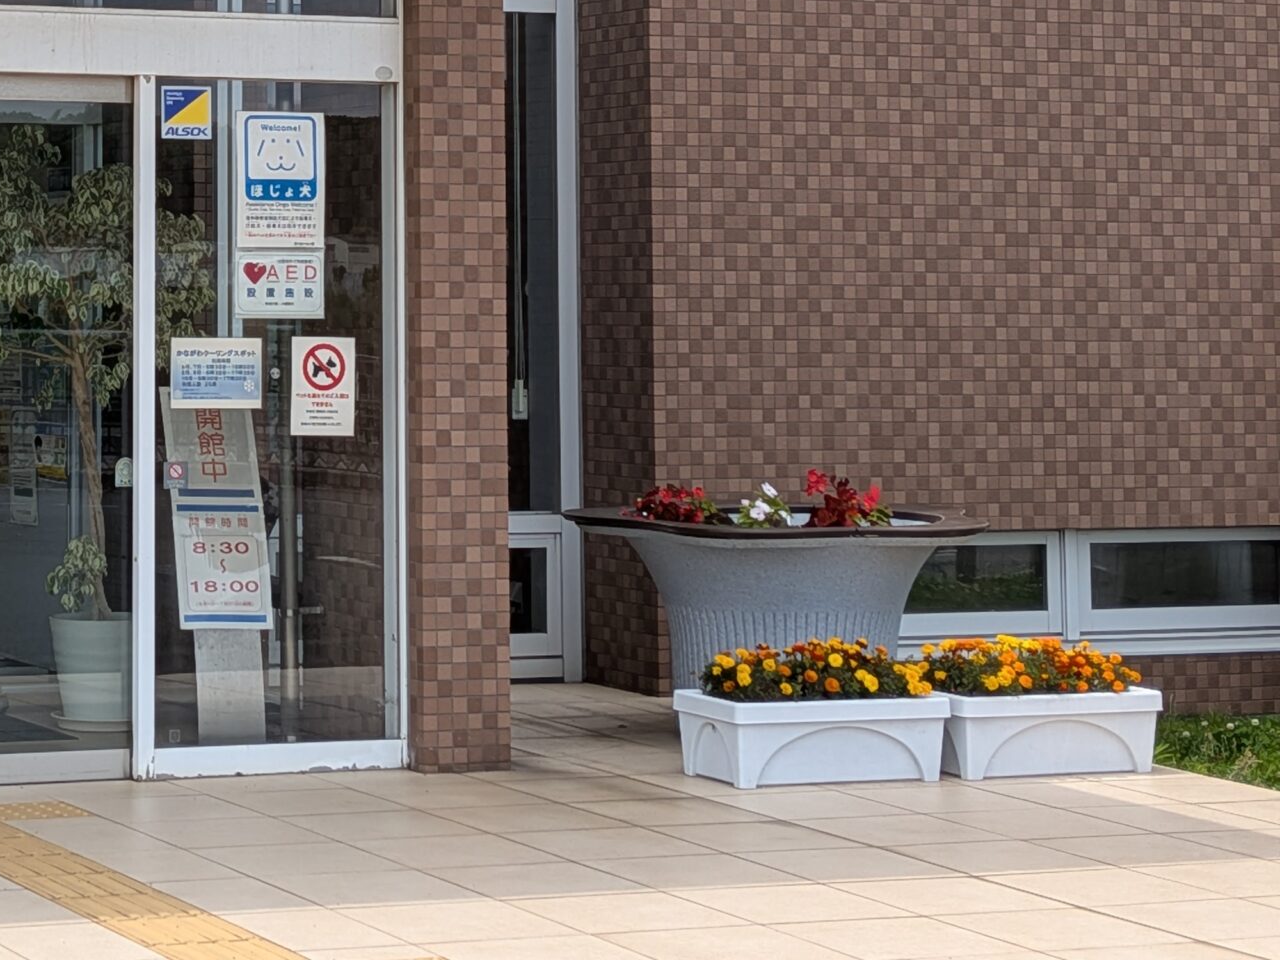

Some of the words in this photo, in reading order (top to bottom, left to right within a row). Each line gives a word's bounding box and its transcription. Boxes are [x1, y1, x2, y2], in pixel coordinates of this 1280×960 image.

[165, 126, 208, 137] ALSOK
[261, 123, 301, 132] Welcome!
[250, 184, 312, 198] ほじょ犬
[266, 264, 317, 280] AED
[195, 408, 227, 483] 開館中
[192, 541, 249, 554] 8:30
[190, 580, 259, 593] 18:00
